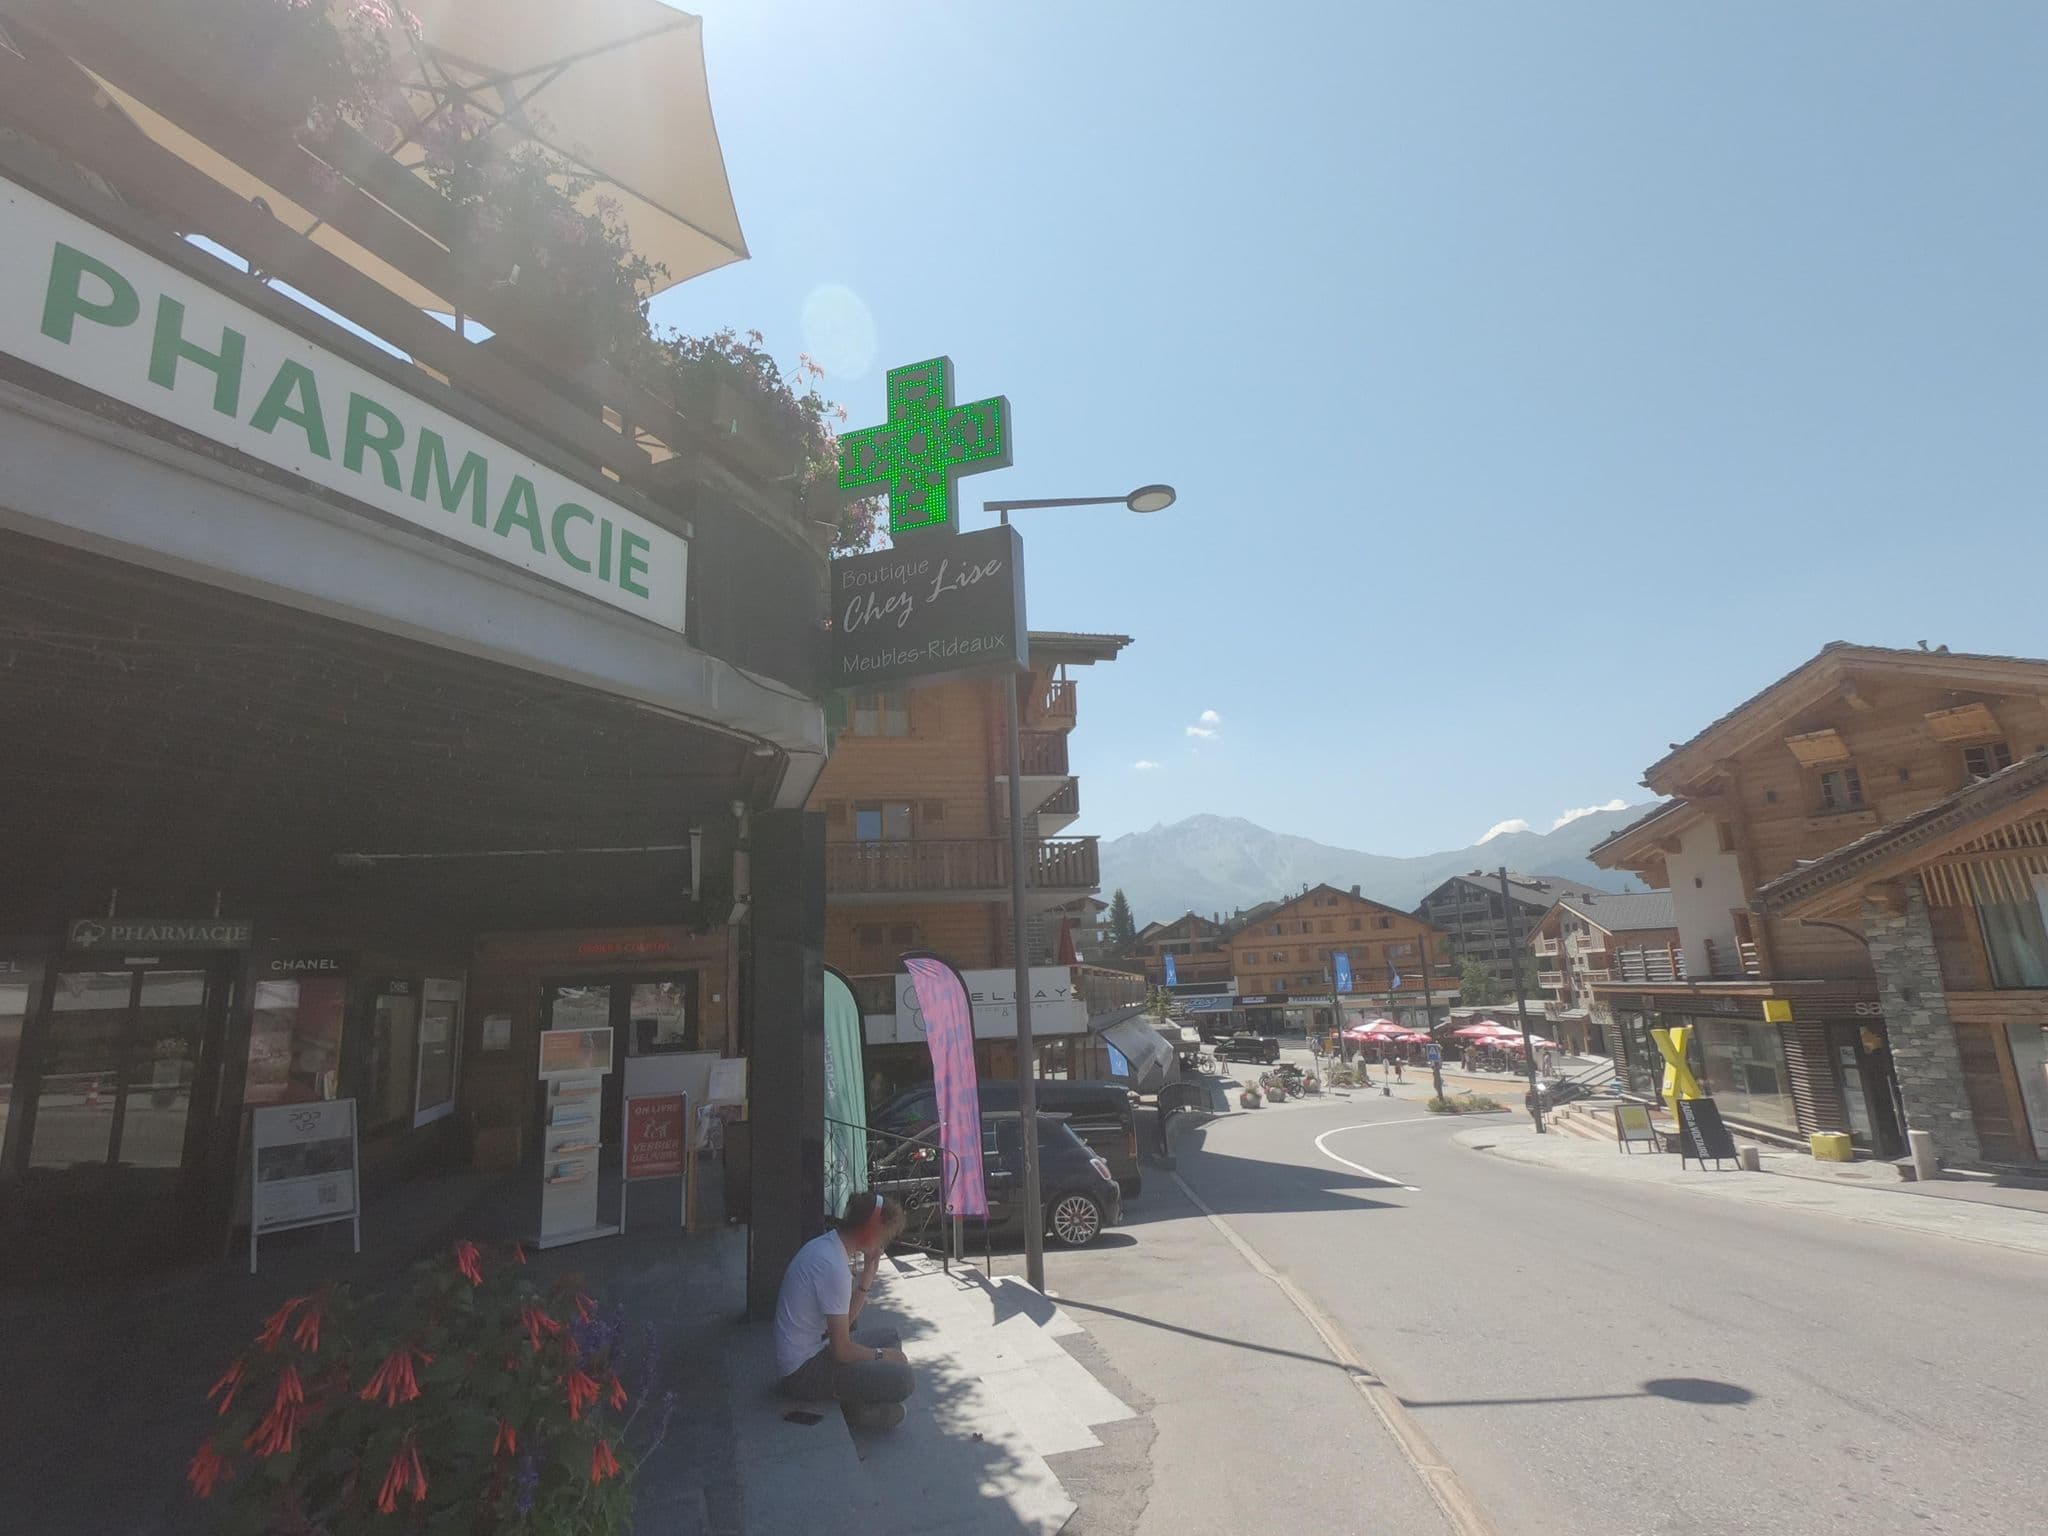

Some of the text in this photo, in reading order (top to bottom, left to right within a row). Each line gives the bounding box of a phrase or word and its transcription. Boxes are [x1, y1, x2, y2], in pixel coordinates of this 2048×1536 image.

[41, 241, 650, 599] PHARMACIE
[843, 560, 929, 589] Boutique
[843, 558, 1002, 632] Chez Lise
[843, 633, 1007, 673] Meubles-Rideaux
[110, 924, 249, 943] PHARMACIE
[271, 959, 338, 971] CHANEL
